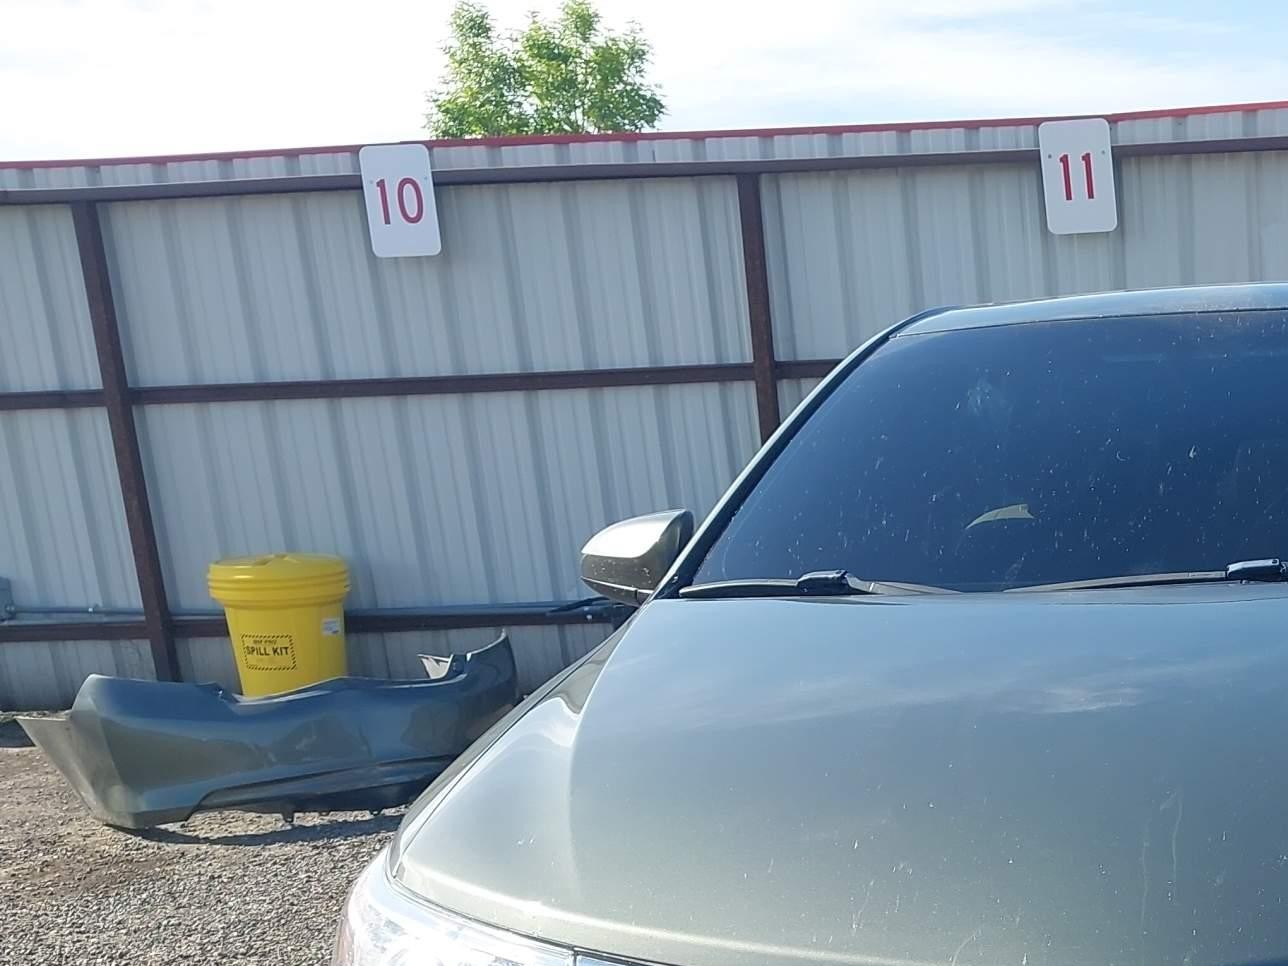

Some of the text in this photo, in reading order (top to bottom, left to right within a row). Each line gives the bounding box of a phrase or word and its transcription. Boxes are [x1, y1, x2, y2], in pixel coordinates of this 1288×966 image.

[1059, 152, 1095, 201] 11
[376, 177, 424, 225] 10
[245, 646, 289, 656] SPILL KIT
